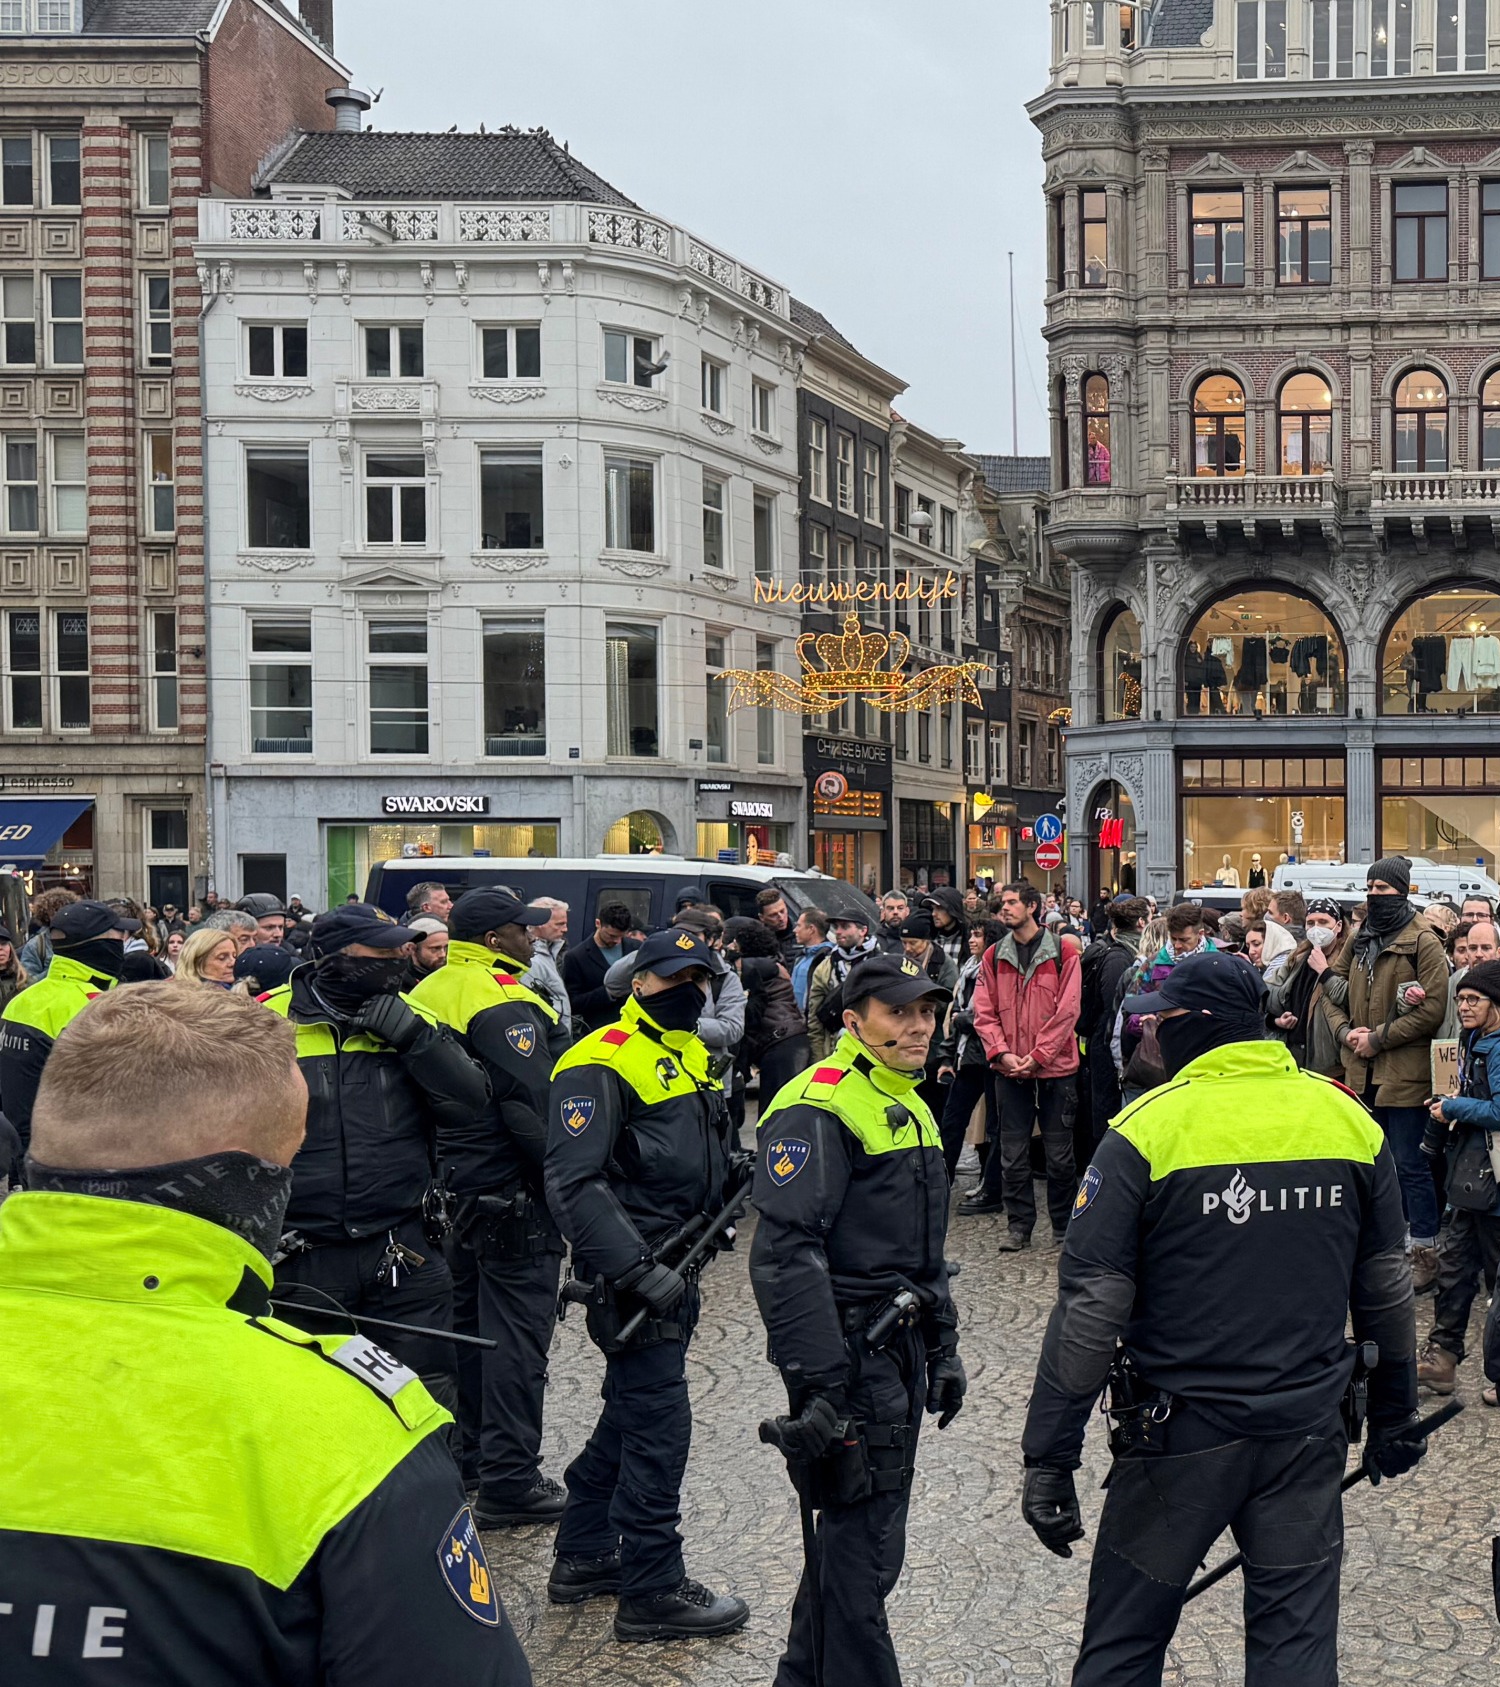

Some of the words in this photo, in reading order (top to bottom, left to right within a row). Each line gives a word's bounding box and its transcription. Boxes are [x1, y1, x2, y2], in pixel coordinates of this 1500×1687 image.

[754, 570, 958, 607] Nieuwendijk
[817, 738, 854, 758] CHSE
[11, 776, 75, 790] espresso
[385, 796, 484, 812] SWAROVSKI
[731, 801, 773, 818] SWAROVSKI
[0, 824, 33, 840] ED
[771, 1142, 806, 1153] POLITIE
[1202, 1167, 1343, 1225] POLITIE
